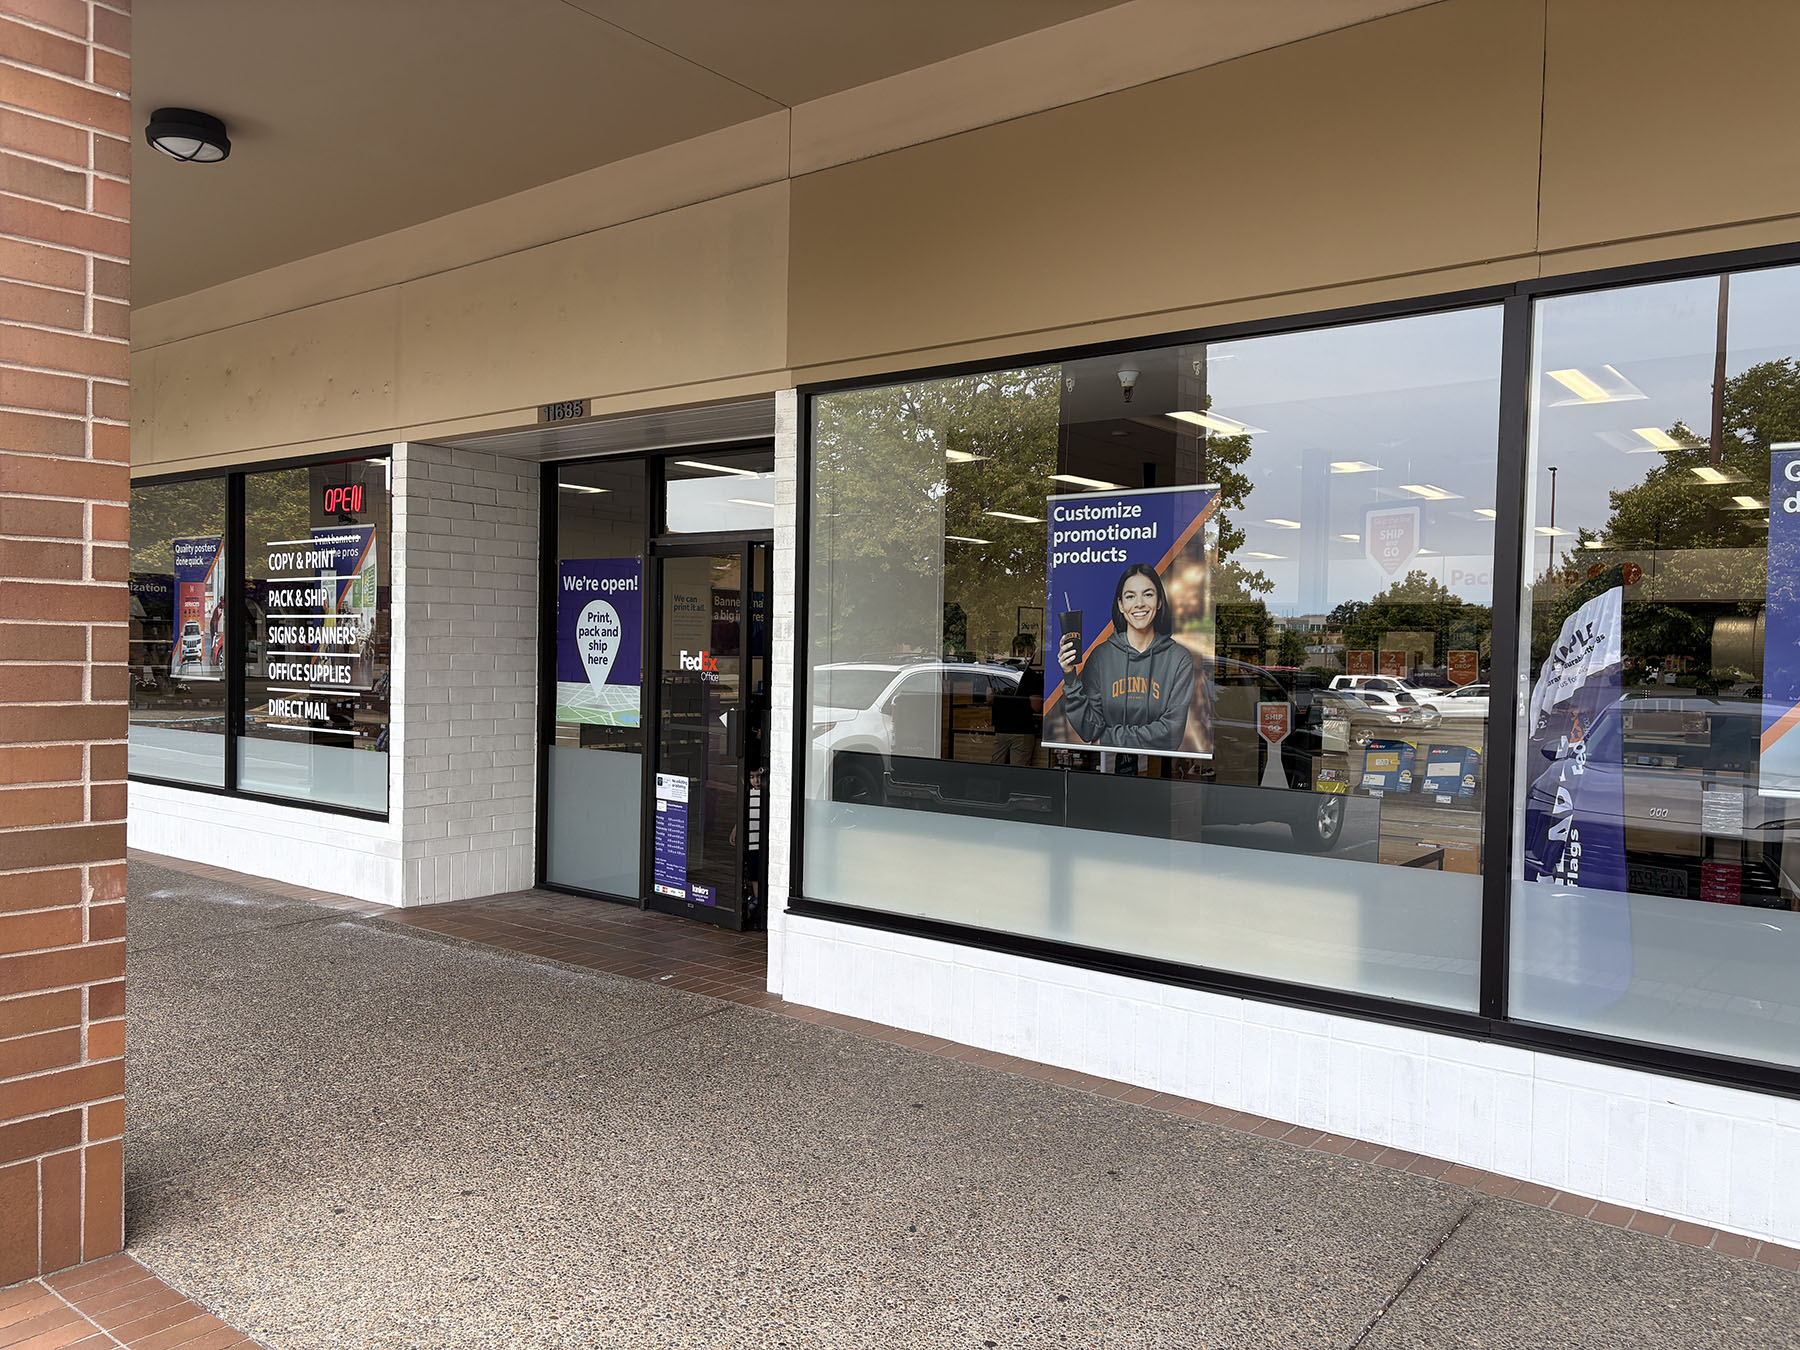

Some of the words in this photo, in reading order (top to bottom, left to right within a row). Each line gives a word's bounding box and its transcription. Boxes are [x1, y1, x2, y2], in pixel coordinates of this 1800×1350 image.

[543, 400, 584, 421] 11685
[324, 484, 363, 513] OPEN
[1053, 501, 1142, 521] Customize
[1053, 522, 1158, 547] promotional
[1379, 528, 1404, 540] SHIP
[175, 544, 194, 555] Quality
[194, 543, 216, 554] posters
[342, 548, 359, 560] pros
[1383, 547, 1399, 557] GO
[175, 556, 189, 566] done
[189, 555, 204, 568] quick
[268, 552, 295, 571] COPY
[296, 552, 304, 570] &
[305, 550, 336, 569] PRINT
[1052, 547, 1128, 568] products
[1451, 568, 1493, 586] Pac
[563, 575, 598, 591] We're
[601, 575, 639, 595] open!
[268, 589, 294, 607] PACK
[295, 589, 304, 607] &
[304, 588, 328, 607] SHIP
[673, 594, 685, 603] We
[673, 604, 690, 613] print
[690, 604, 696, 612] it
[587, 611, 613, 625] Print,
[720, 611, 734, 623] big
[268, 626, 297, 644] SIGNS
[298, 626, 307, 644] &
[307, 626, 357, 645] BANNERS
[578, 626, 600, 639] pack
[601, 626, 619, 637] and
[588, 639, 608, 653] ship
[587, 653, 609, 665] here
[679, 649, 719, 672] FedEx
[1389, 654, 1396, 663] 2
[1460, 654, 1467, 663] 3
[268, 662, 303, 681] OFFICE
[303, 664, 352, 684] SUPPLIES
[700, 671, 719, 682] Office
[268, 698, 304, 718] DIRECT
[304, 701, 330, 721] MAIL
